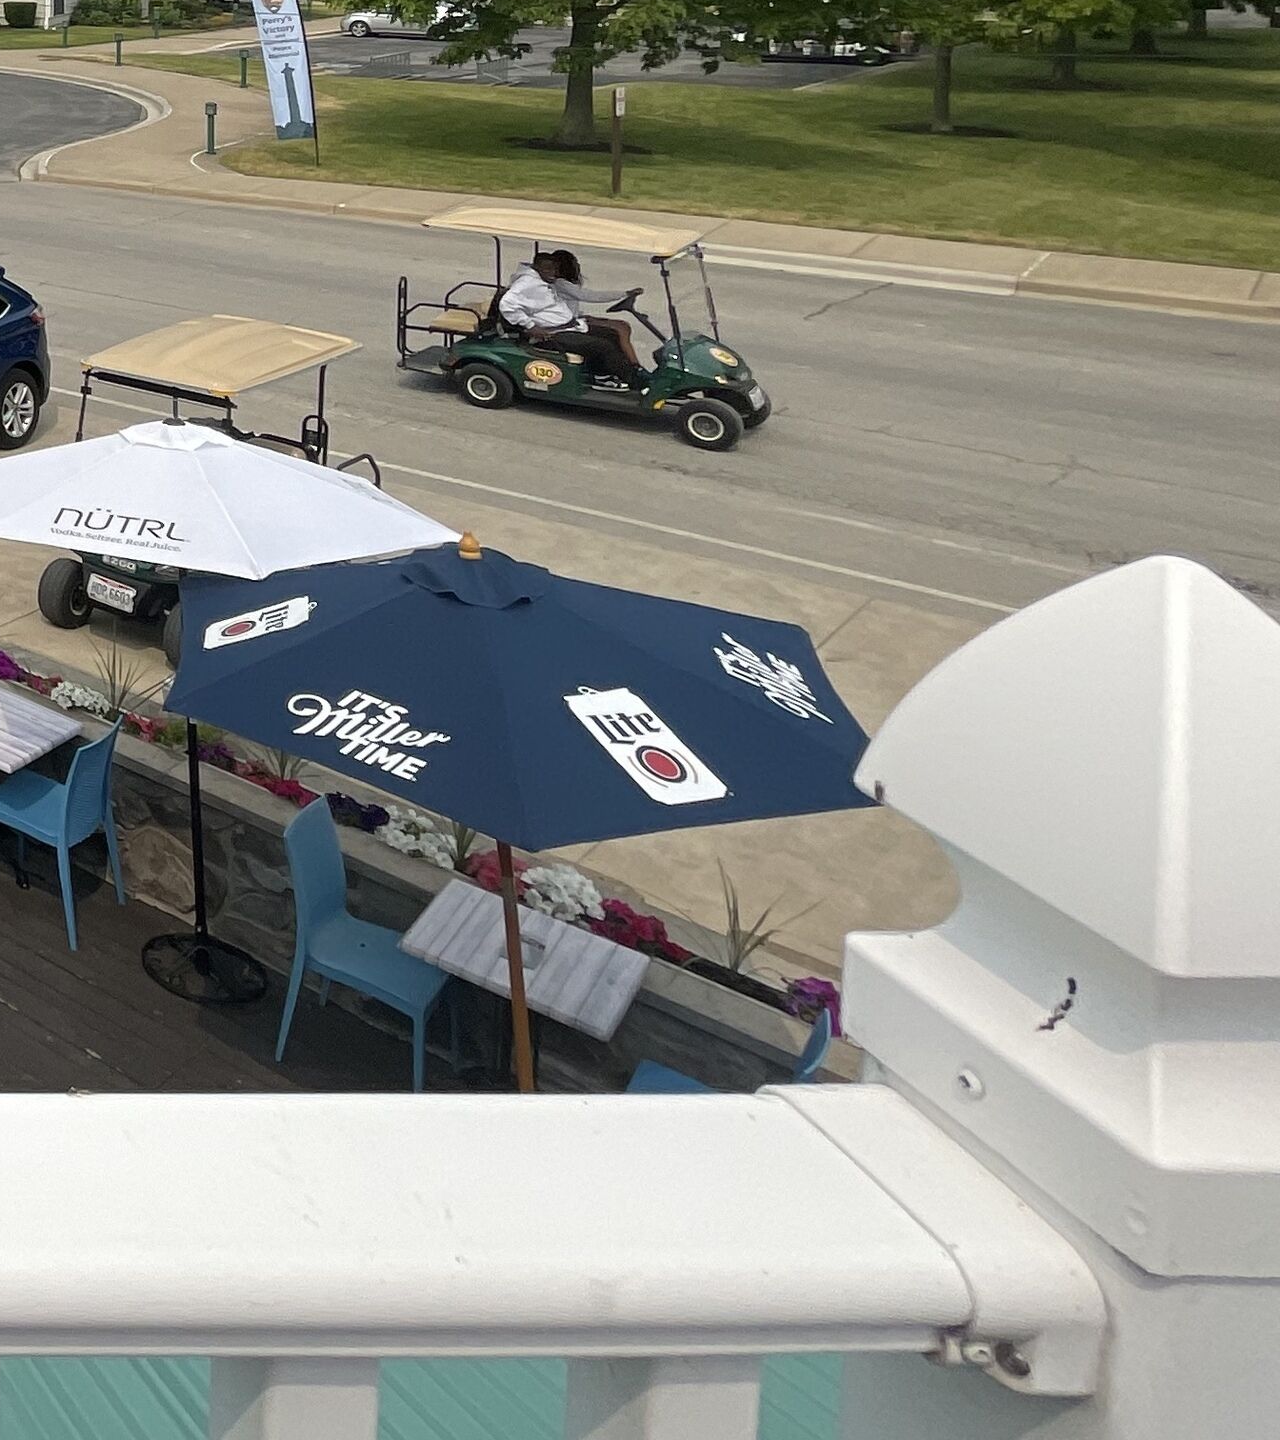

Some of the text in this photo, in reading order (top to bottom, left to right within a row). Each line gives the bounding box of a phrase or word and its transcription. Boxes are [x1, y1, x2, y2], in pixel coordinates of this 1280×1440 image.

[262, 16, 292, 25] Perry's
[263, 25, 294, 34] Victory
[534, 366, 554, 378] 130
[125, 537, 149, 548] Real
[259, 604, 289, 631] Lite
[288, 693, 452, 748] Miller
[337, 689, 409, 725] IT'S
[586, 712, 662, 746] Lite
[339, 736, 428, 781] TIME
